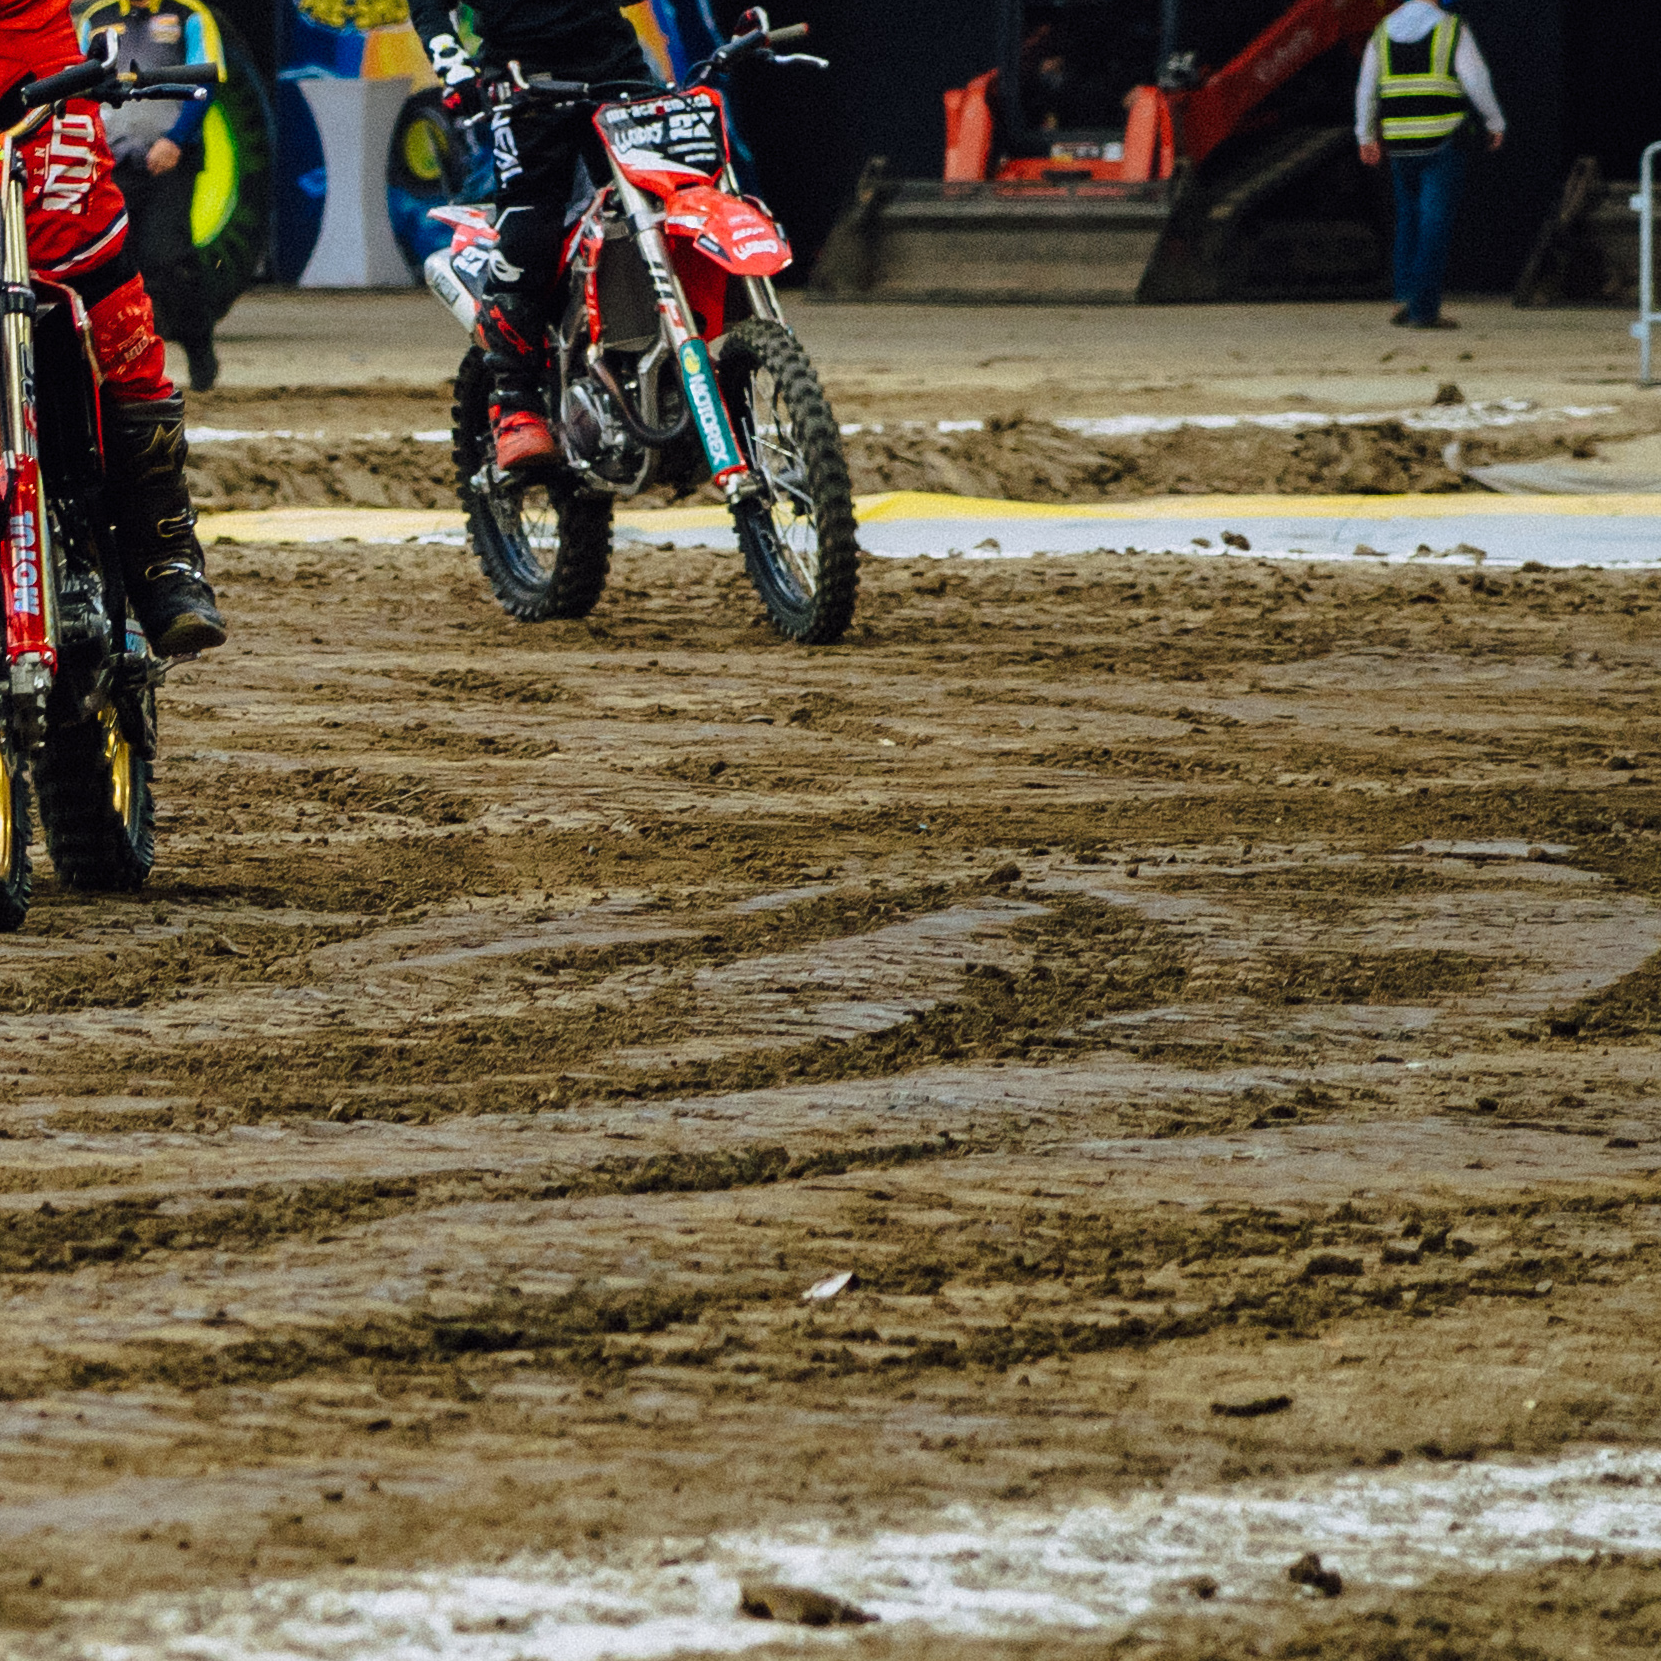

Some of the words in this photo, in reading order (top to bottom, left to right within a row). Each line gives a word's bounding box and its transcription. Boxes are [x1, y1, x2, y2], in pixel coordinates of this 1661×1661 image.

[41, 113, 96, 215] MUD
[689, 373, 730, 465] MOTOREX
[9, 511, 40, 616] MOTUL
